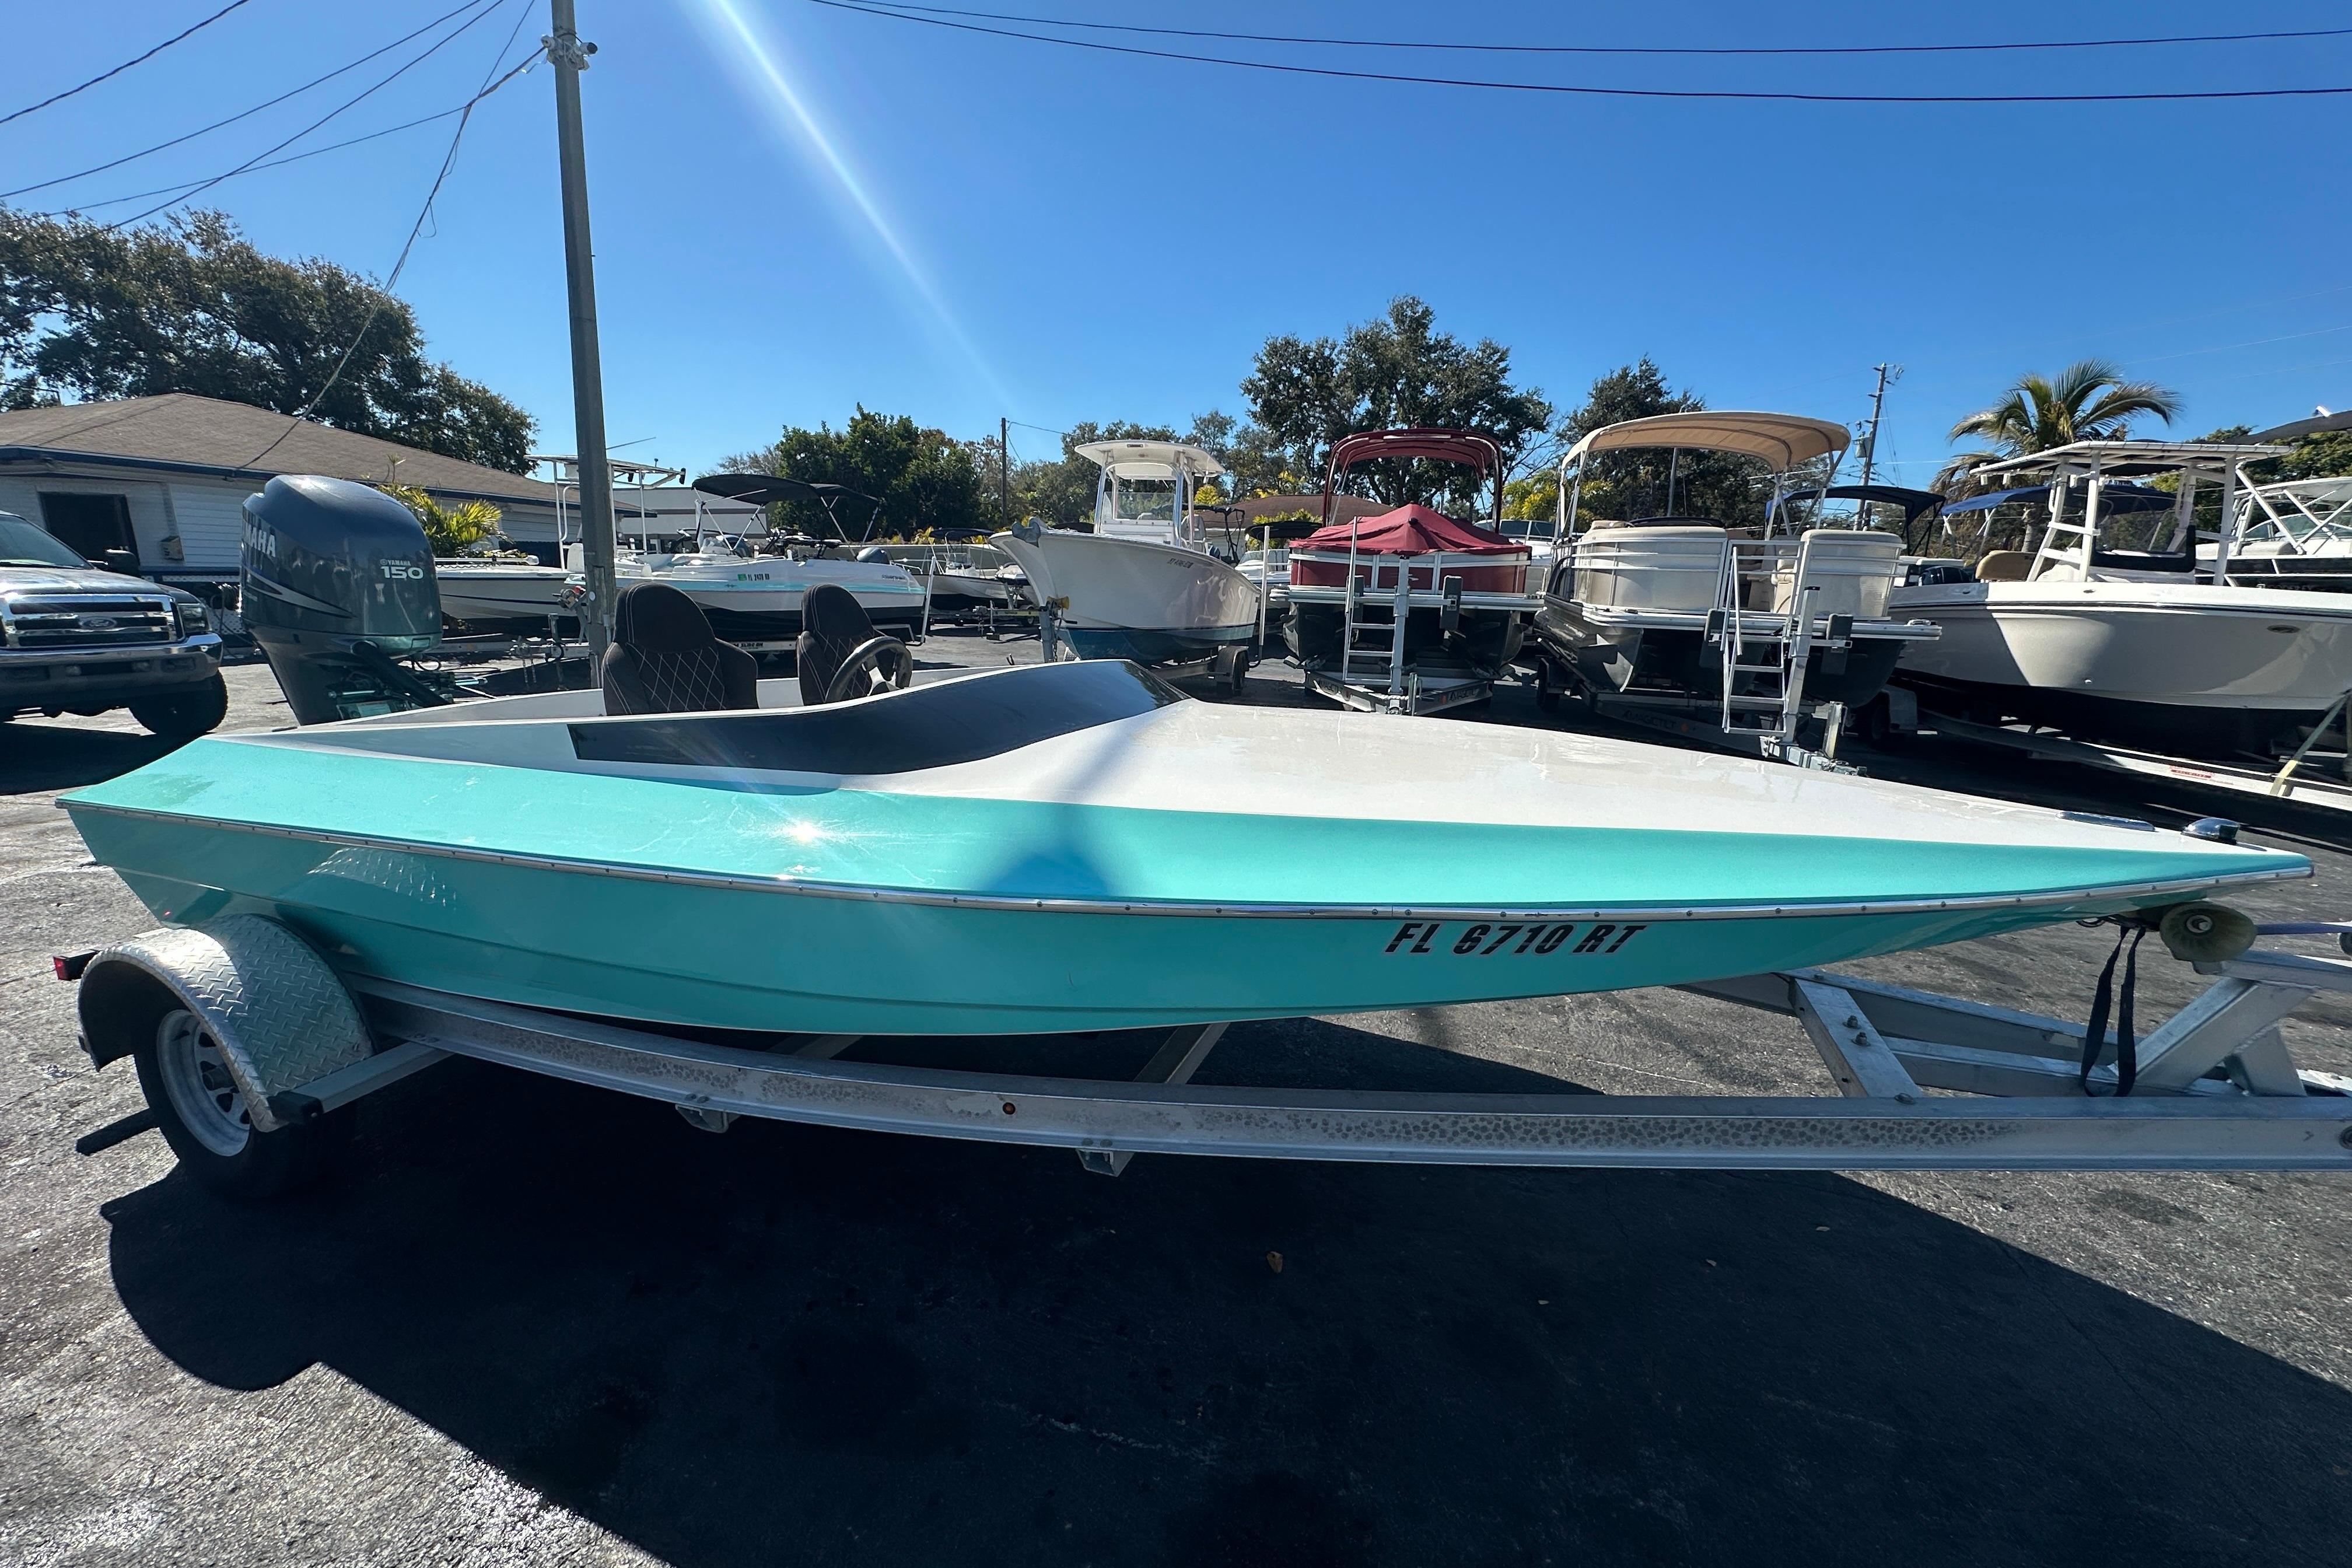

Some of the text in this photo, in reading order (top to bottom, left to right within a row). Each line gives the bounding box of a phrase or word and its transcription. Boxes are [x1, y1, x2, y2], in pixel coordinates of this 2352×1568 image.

[243, 522, 276, 558] MAHA
[380, 566, 424, 579] 150
[1385, 923, 1648, 956] FL 6710 RT
